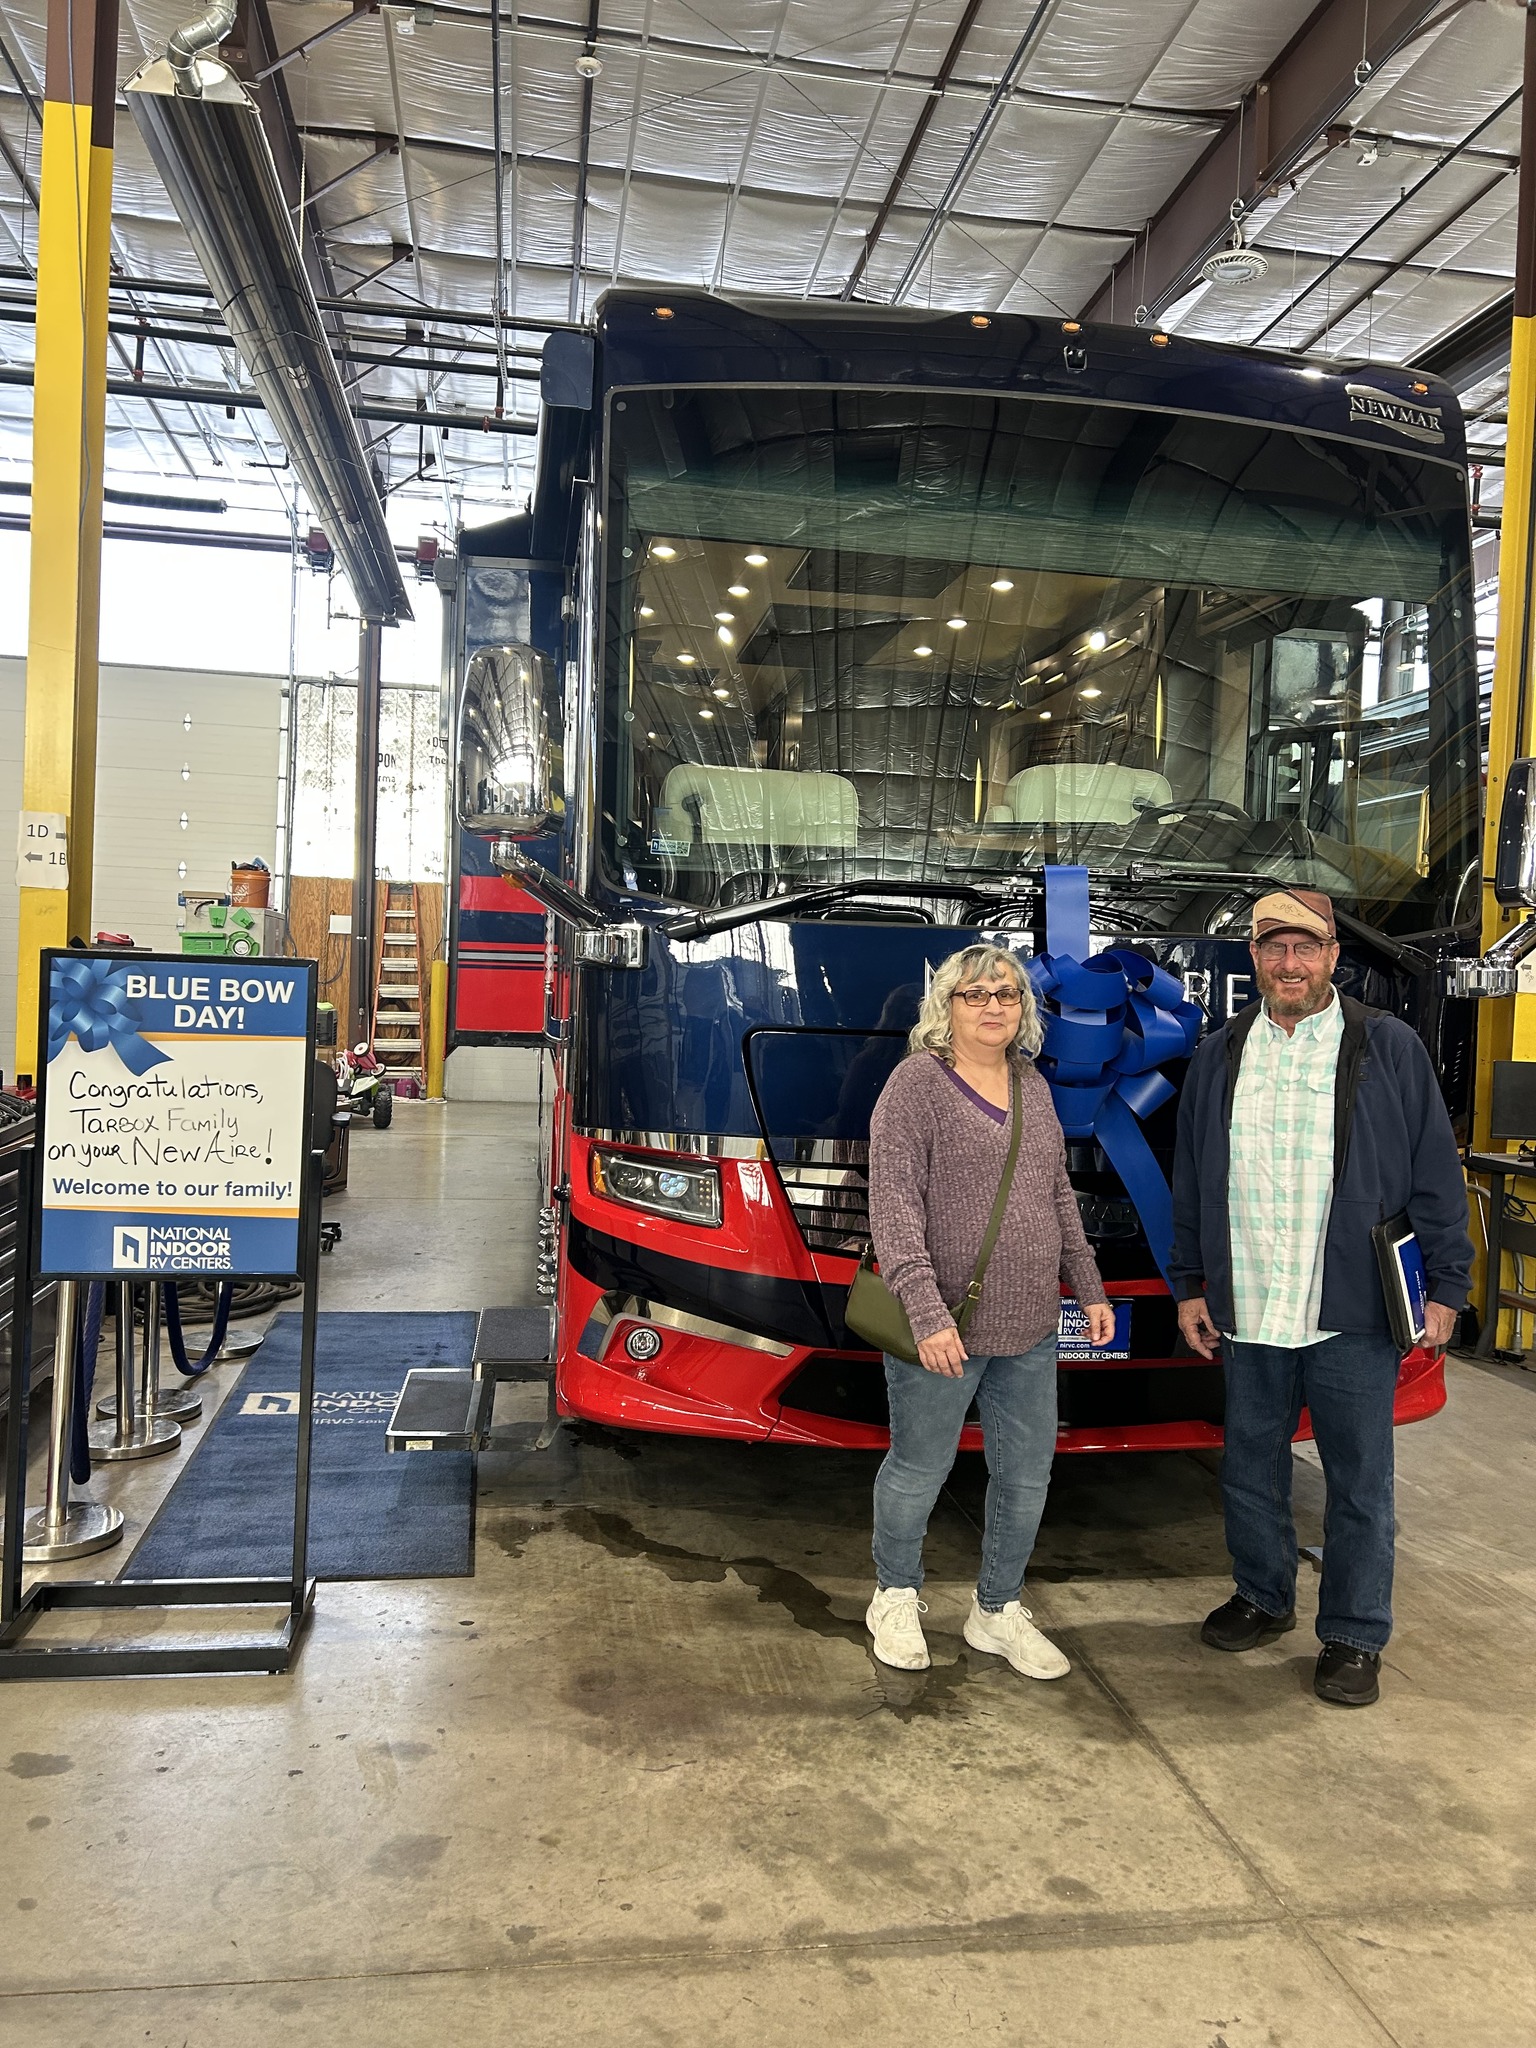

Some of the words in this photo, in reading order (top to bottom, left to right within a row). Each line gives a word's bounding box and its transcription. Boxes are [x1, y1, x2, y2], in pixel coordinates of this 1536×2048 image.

[1350, 396, 1443, 431] NEWMAR
[27, 824, 49, 838] 1D
[49, 851, 66, 866] 1B
[126, 975, 210, 1000] BLUE
[220, 978, 295, 1004] BOW
[174, 1004, 245, 1029] DAY!
[69, 1070, 264, 1108] Congratulations,
[167, 1107, 239, 1138] Family
[48, 1143, 76, 1161] on
[52, 1177, 150, 1196] Welcome
[157, 1180, 177, 1196] to
[184, 1183, 219, 1197] our
[225, 1180, 293, 1201] family!
[150, 1226, 232, 1241] NATIONAL
[150, 1241, 231, 1256] INDOOR
[149, 1257, 168, 1269] RV
[1063, 1319, 1091, 1328] INDO
[313, 1390, 400, 1399] NATIO
